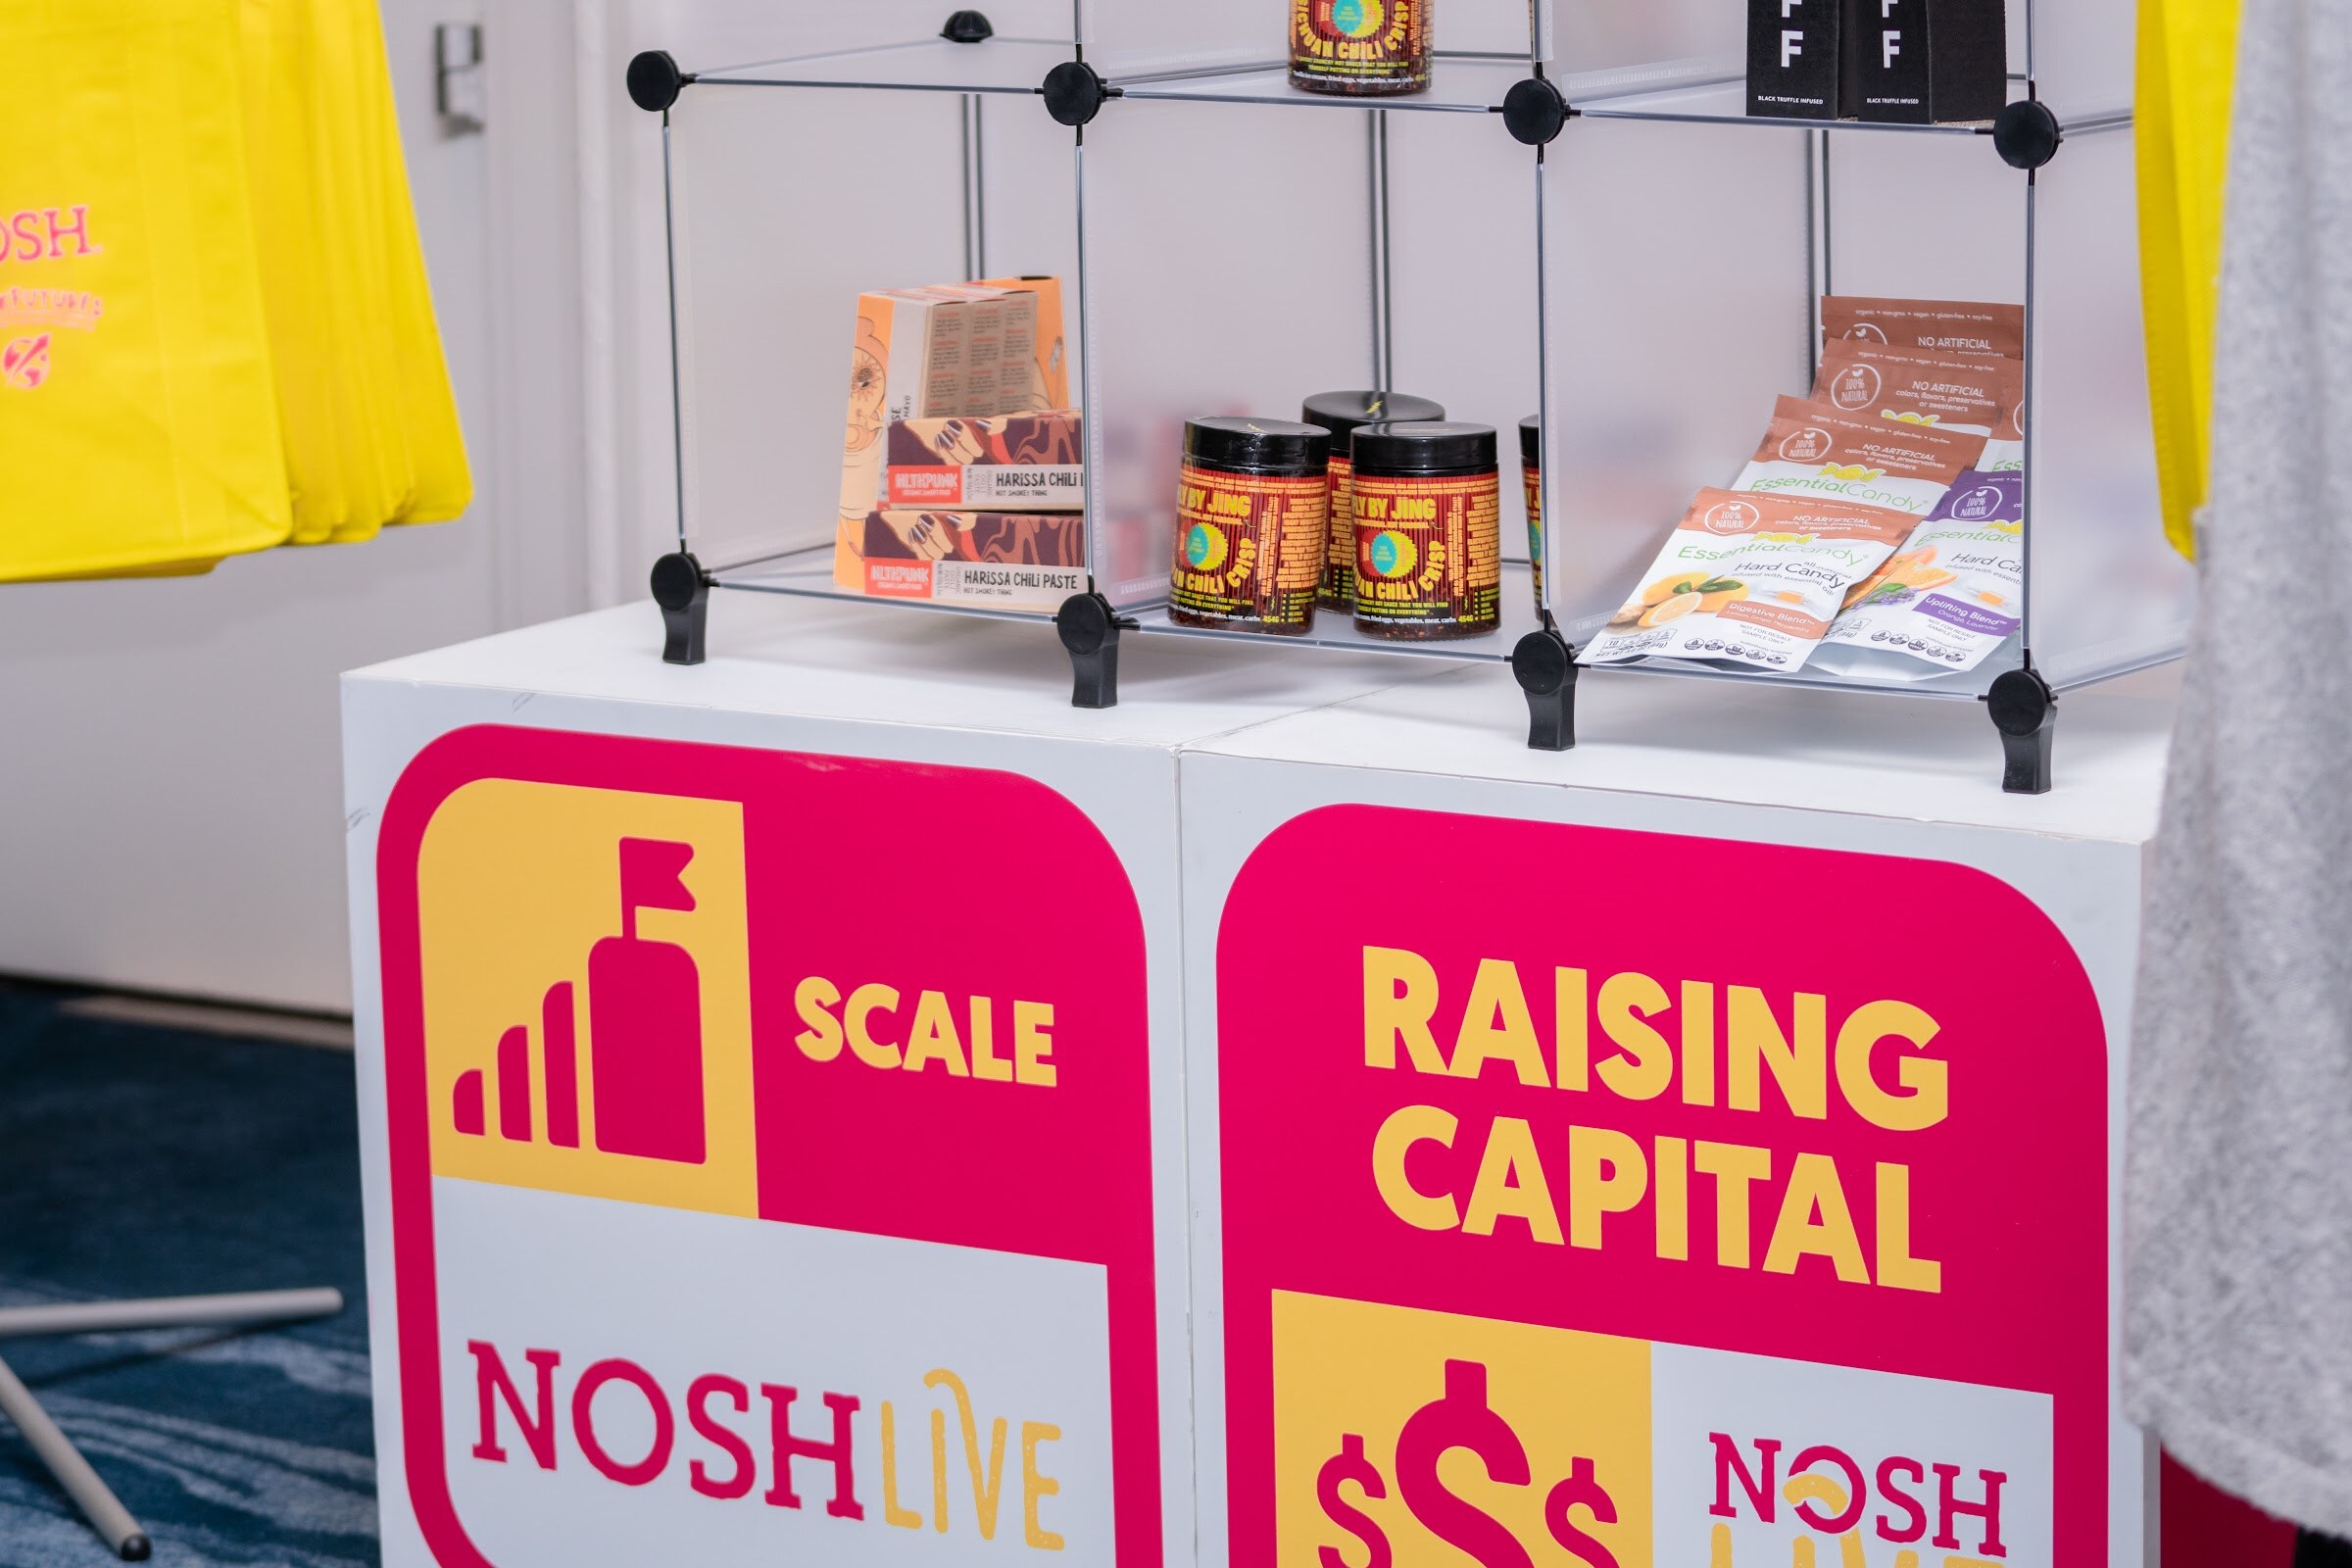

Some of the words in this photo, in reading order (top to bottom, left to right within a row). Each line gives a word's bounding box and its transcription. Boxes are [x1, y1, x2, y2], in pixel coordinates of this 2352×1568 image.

[1298, 0, 1334, 58] ICHUAN
[1384, 1, 1409, 50] CRISP
[1918, 336, 1935, 346] NO
[1937, 337, 1991, 350] ARTIFICIAL
[1845, 378, 1865, 390] 100%
[1912, 380, 1930, 390] NO
[1931, 383, 1984, 397] ARTIFICIAL
[1841, 391, 1868, 402] NATURAL
[1895, 389, 1919, 399] colors,
[1921, 391, 1946, 402] flavors,
[1947, 395, 1995, 407] preservatives
[1929, 402, 1968, 413] sweeteners
[1795, 439, 1816, 448] 100%
[1788, 448, 1817, 458] NATURAL
[1844, 448, 1868, 457] colors,
[1869, 451, 1894, 462] flavors,
[1895, 454, 1946, 468] preservatives
[1862, 443, 1882, 452] NO
[1883, 445, 1936, 461] ARTIFICIAL
[1876, 457, 1917, 470] sweeteners
[1188, 486, 1206, 510] BY
[1967, 496, 1986, 507] 100%
[1368, 497, 1388, 518] BY
[1721, 511, 1741, 519] 100%
[1960, 507, 1986, 517] NATURAL
[1716, 519, 1744, 529] NATURAL
[1226, 537, 1256, 588] CRISP
[1418, 540, 1446, 591] CRISP
[1951, 554, 1998, 565] Hard
[1043, 574, 1078, 590] PASTE
[1735, 562, 1783, 571] Hard
[1786, 563, 1844, 589] Candy
[1729, 603, 1775, 617] Digestive
[1926, 596, 1968, 616] Uplifting
[1774, 620, 1810, 633] Peppermint
[1937, 610, 1965, 623] Orange,
[1966, 620, 2000, 631] Lavender
[1741, 629, 1767, 640] SAMPLE
[1768, 631, 1791, 641] RESALE
[1927, 624, 1951, 636] SAMPLE
[1953, 628, 1977, 639] RESALE
[794, 976, 1056, 1088] SCALE
[1363, 945, 1948, 1131] RAISING
[1372, 1104, 1941, 1294] CAPITAL
[467, 1339, 864, 1522] NOSH
[1709, 1432, 2007, 1558] NOSH
